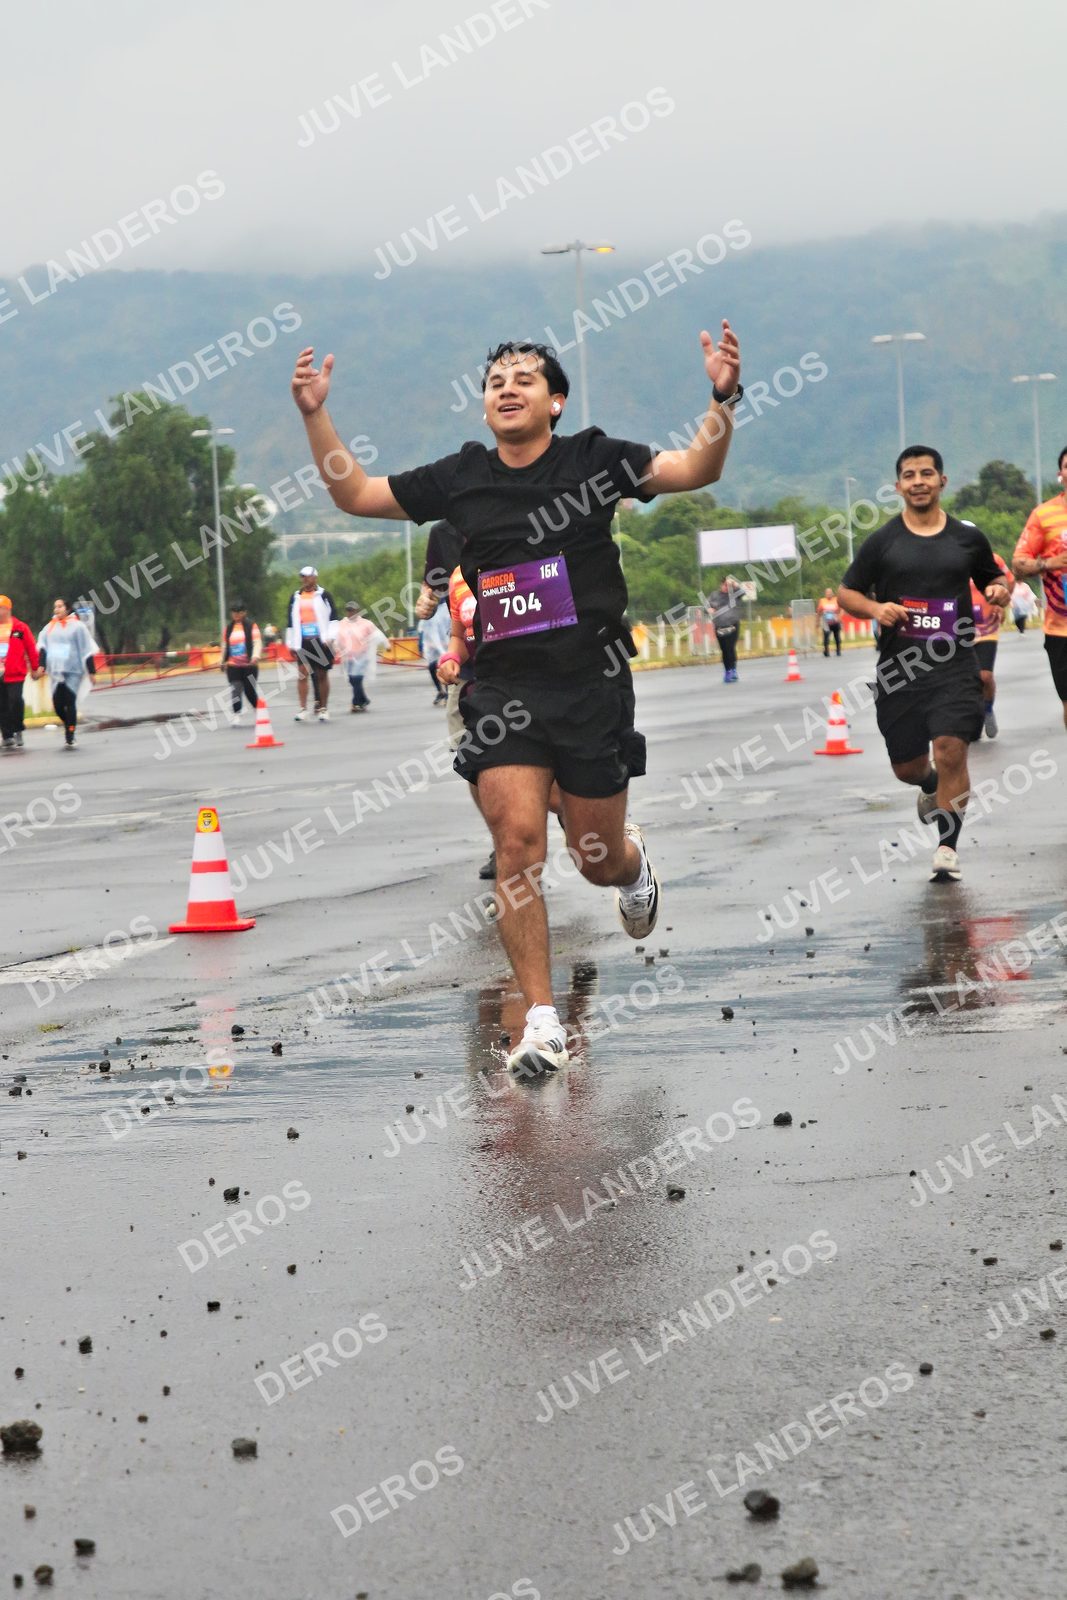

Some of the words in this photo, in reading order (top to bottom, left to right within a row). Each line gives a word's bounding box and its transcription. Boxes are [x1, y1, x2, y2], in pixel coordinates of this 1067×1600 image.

[482, 572, 514, 589] CARRERA
[500, 592, 542, 618] 704
[913, 615, 941, 629] 368
